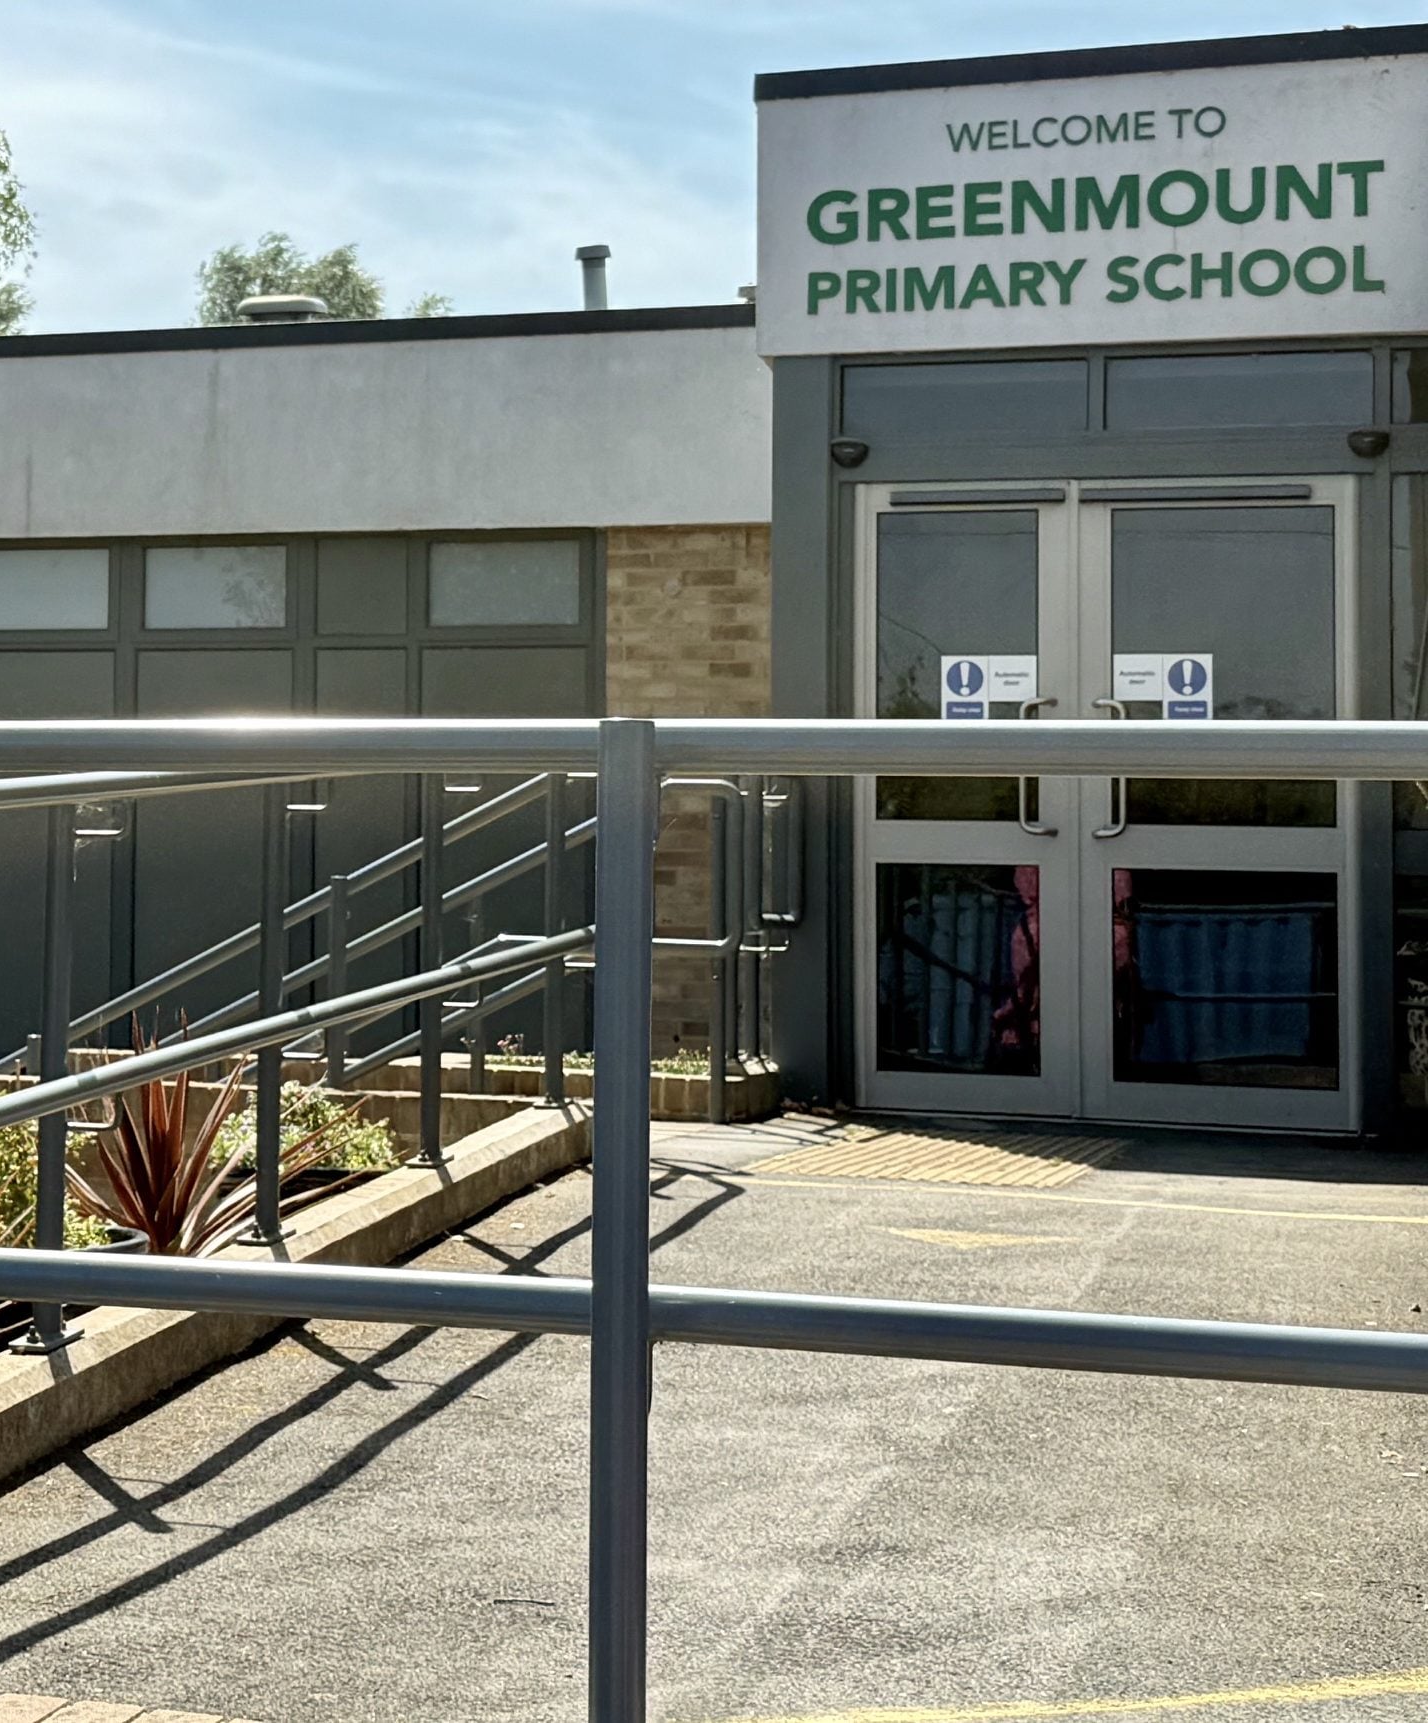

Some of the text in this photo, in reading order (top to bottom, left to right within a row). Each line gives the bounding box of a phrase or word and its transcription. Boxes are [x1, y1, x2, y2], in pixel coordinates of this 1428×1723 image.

[946, 106, 1227, 152] WELCOME TO
[806, 159, 1385, 246] GREENMOUNT
[806, 245, 1386, 316] PRIMARY SCHOOL
